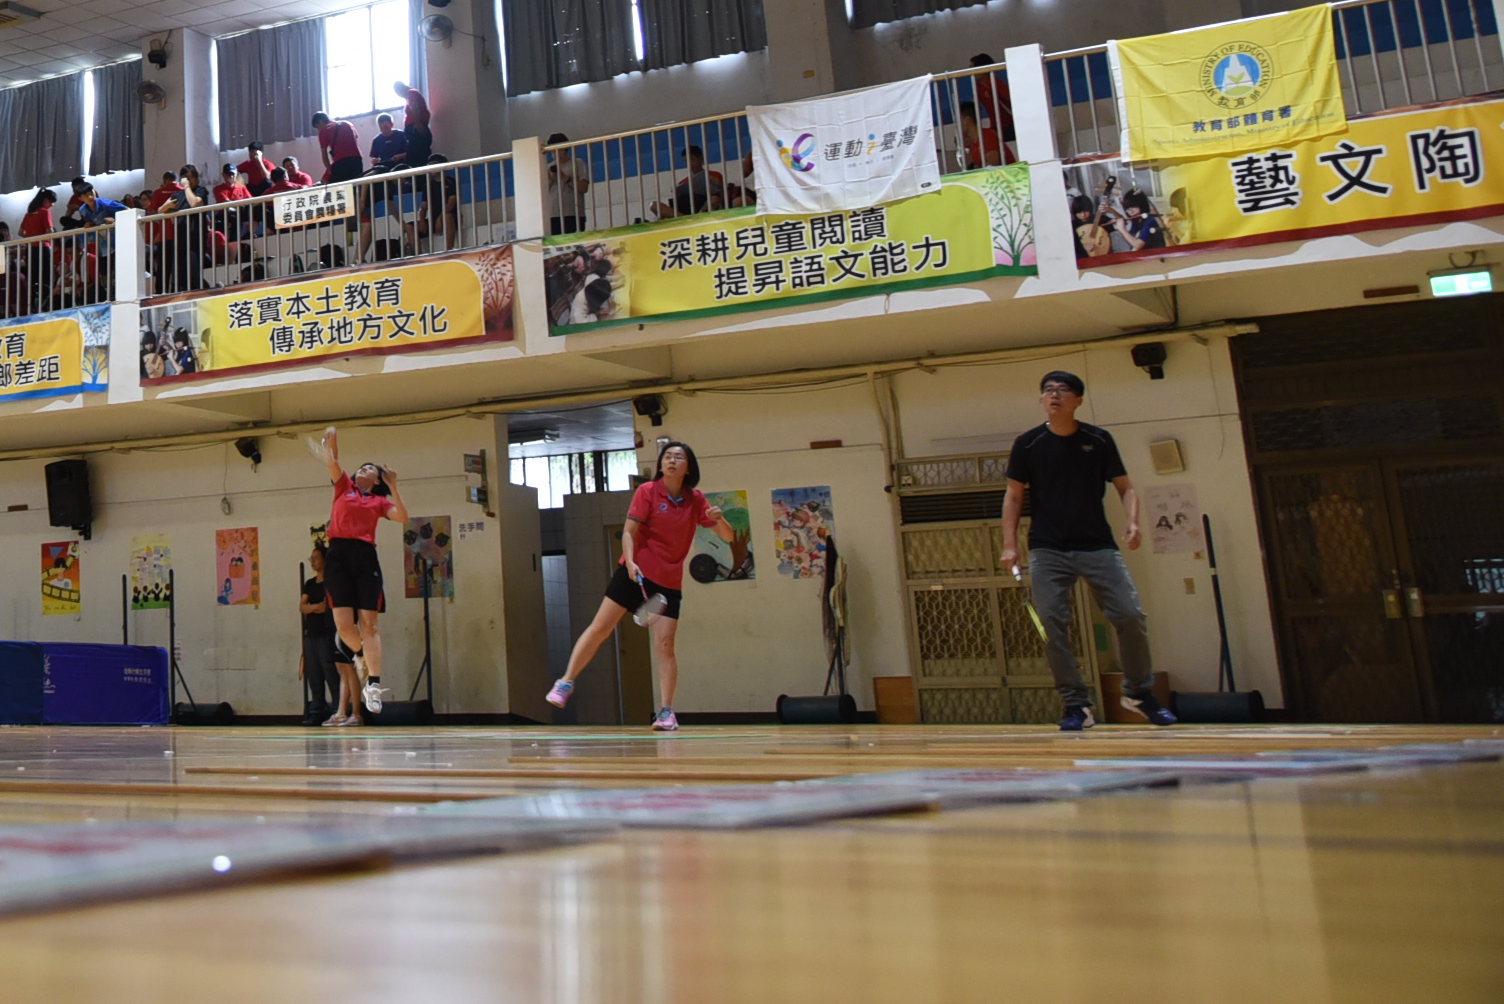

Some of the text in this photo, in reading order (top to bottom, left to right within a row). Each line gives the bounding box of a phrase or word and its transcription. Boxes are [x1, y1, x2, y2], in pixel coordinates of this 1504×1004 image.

[1201, 43, 1271, 97] MINISTRY OF EDUCATION
[1192, 105, 1293, 134] 教育部體育署
[659, 206, 886, 272] 深耕兒童閱讀
[714, 236, 948, 300] 提昇語文能力
[228, 277, 402, 330] 落實本土教育
[269, 304, 448, 356] 傳承地方文化
